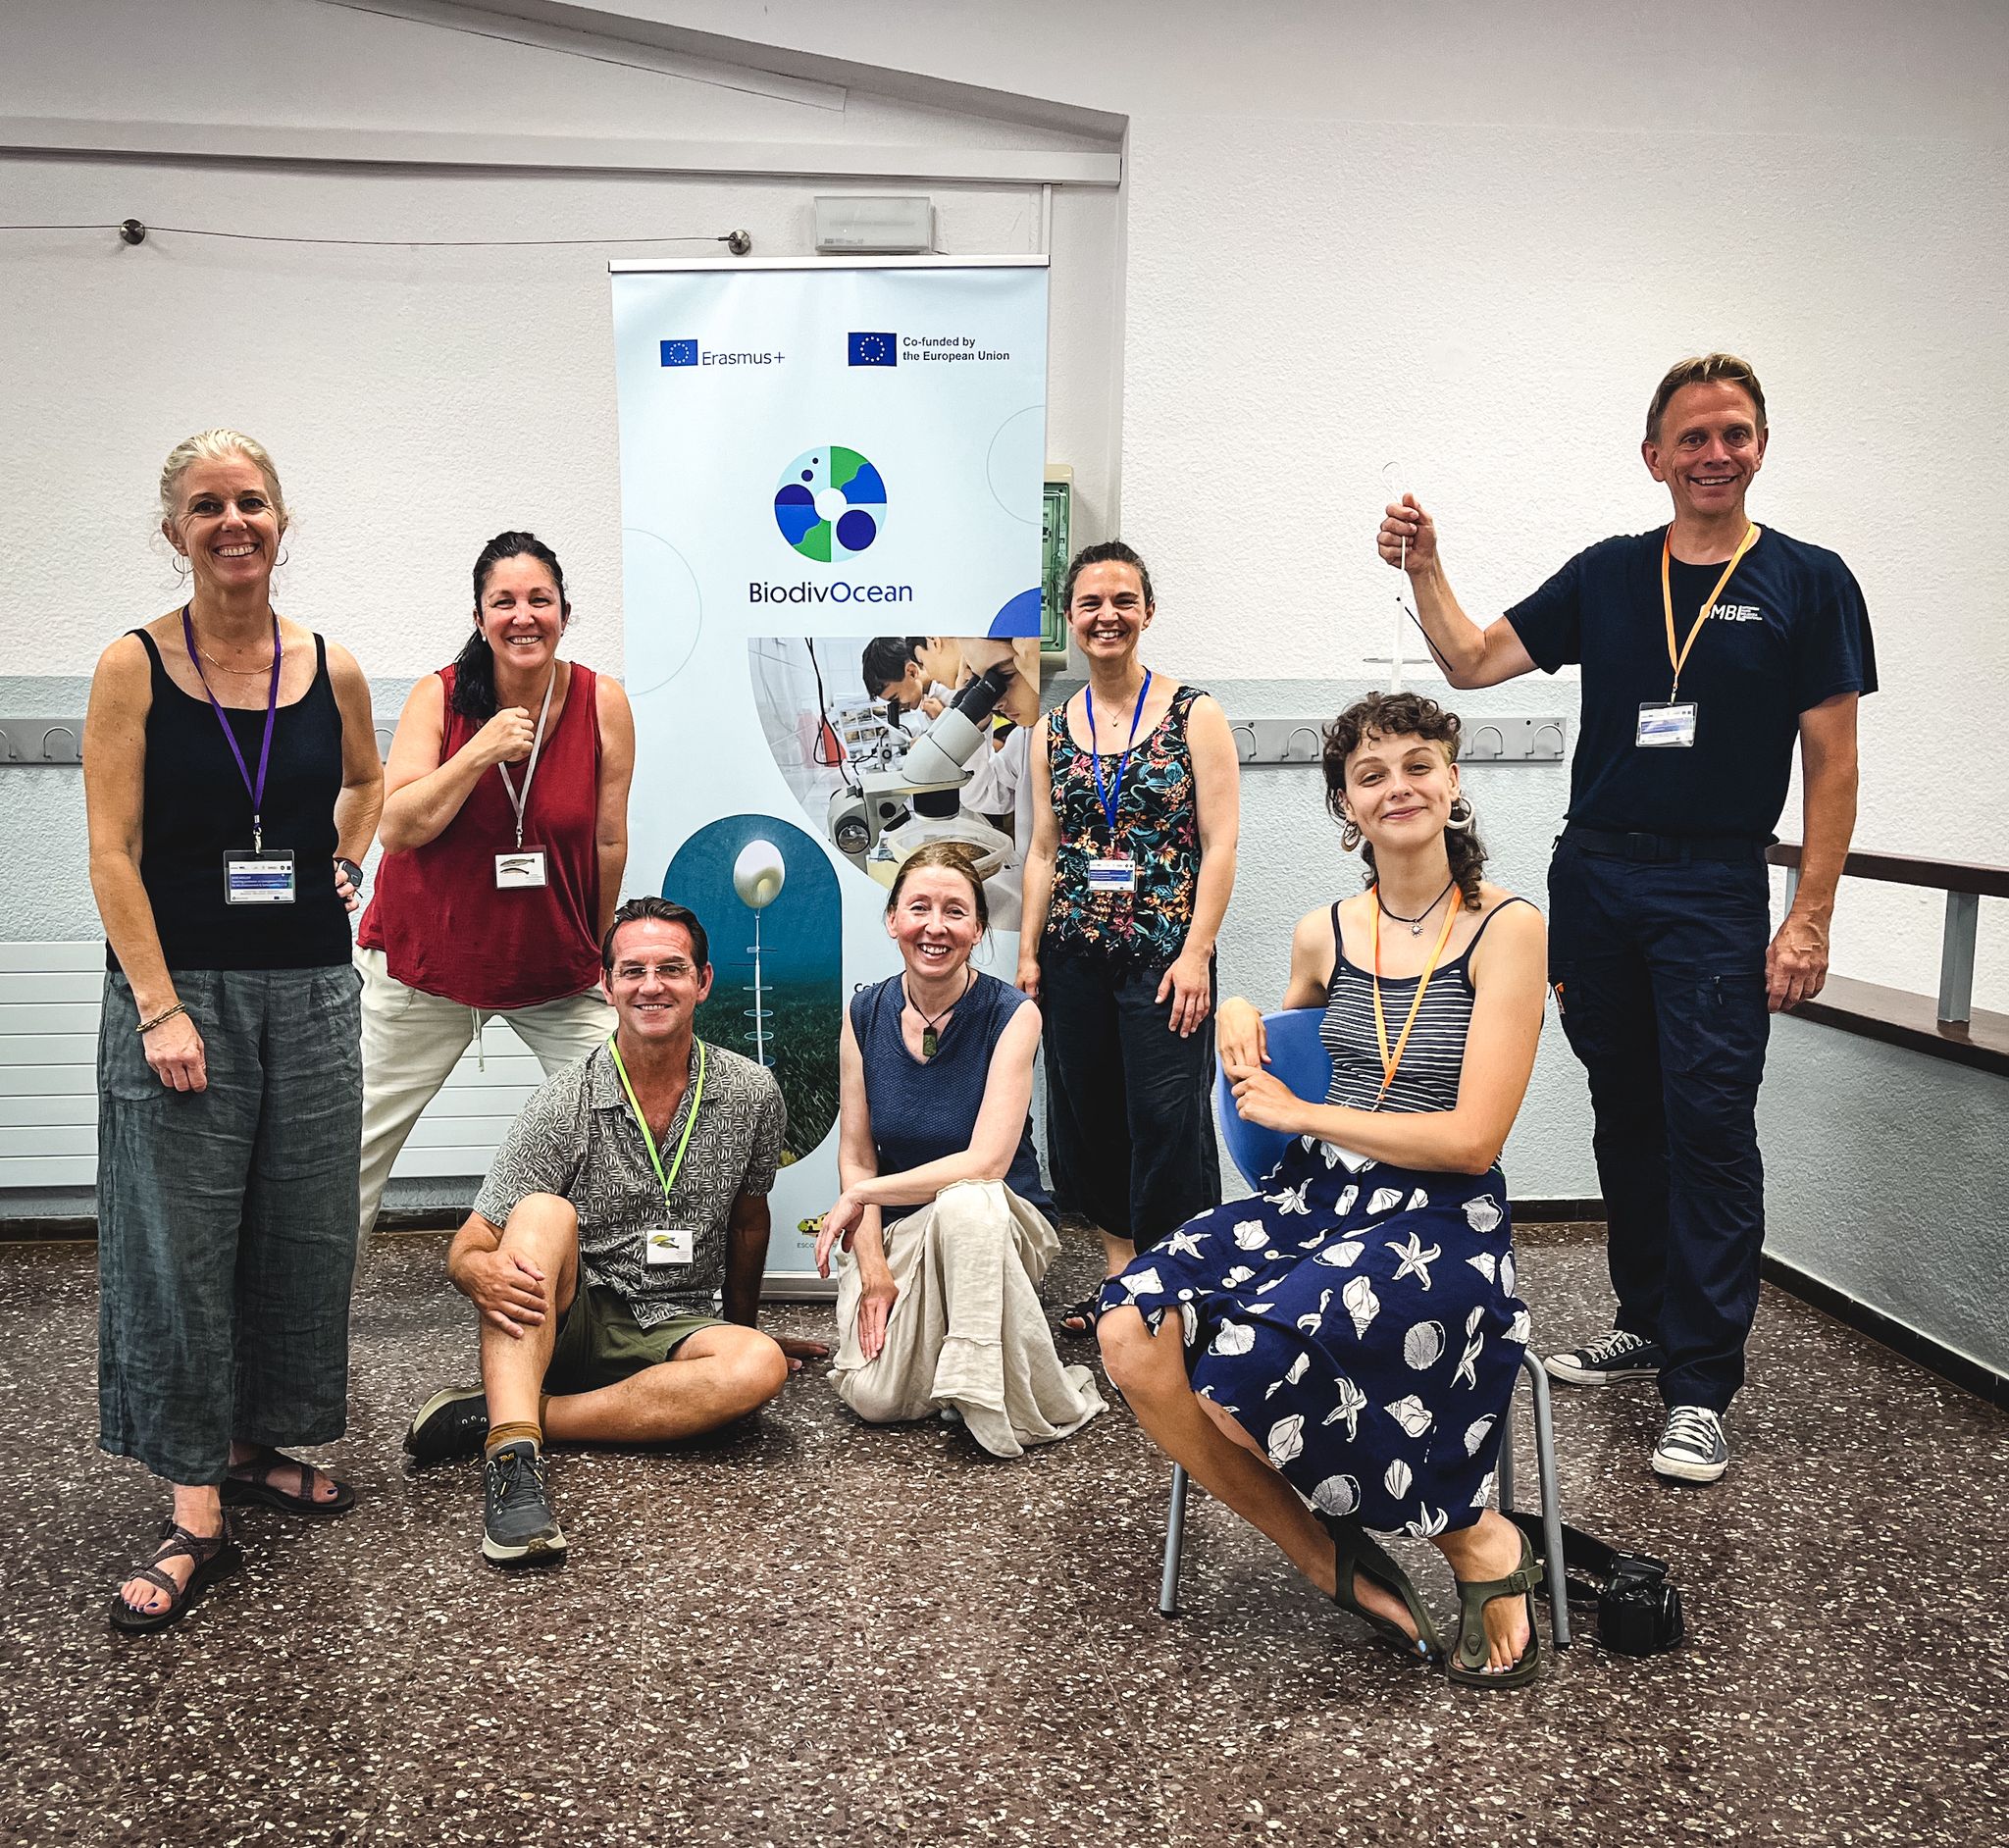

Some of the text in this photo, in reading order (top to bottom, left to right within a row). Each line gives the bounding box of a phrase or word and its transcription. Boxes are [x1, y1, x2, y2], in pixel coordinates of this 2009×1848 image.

[902, 336, 976, 350] Co-funded by
[701, 350, 786, 366] Erasmus+
[902, 350, 1010, 364] the European Union
[748, 581, 913, 604] BiodivOcean
